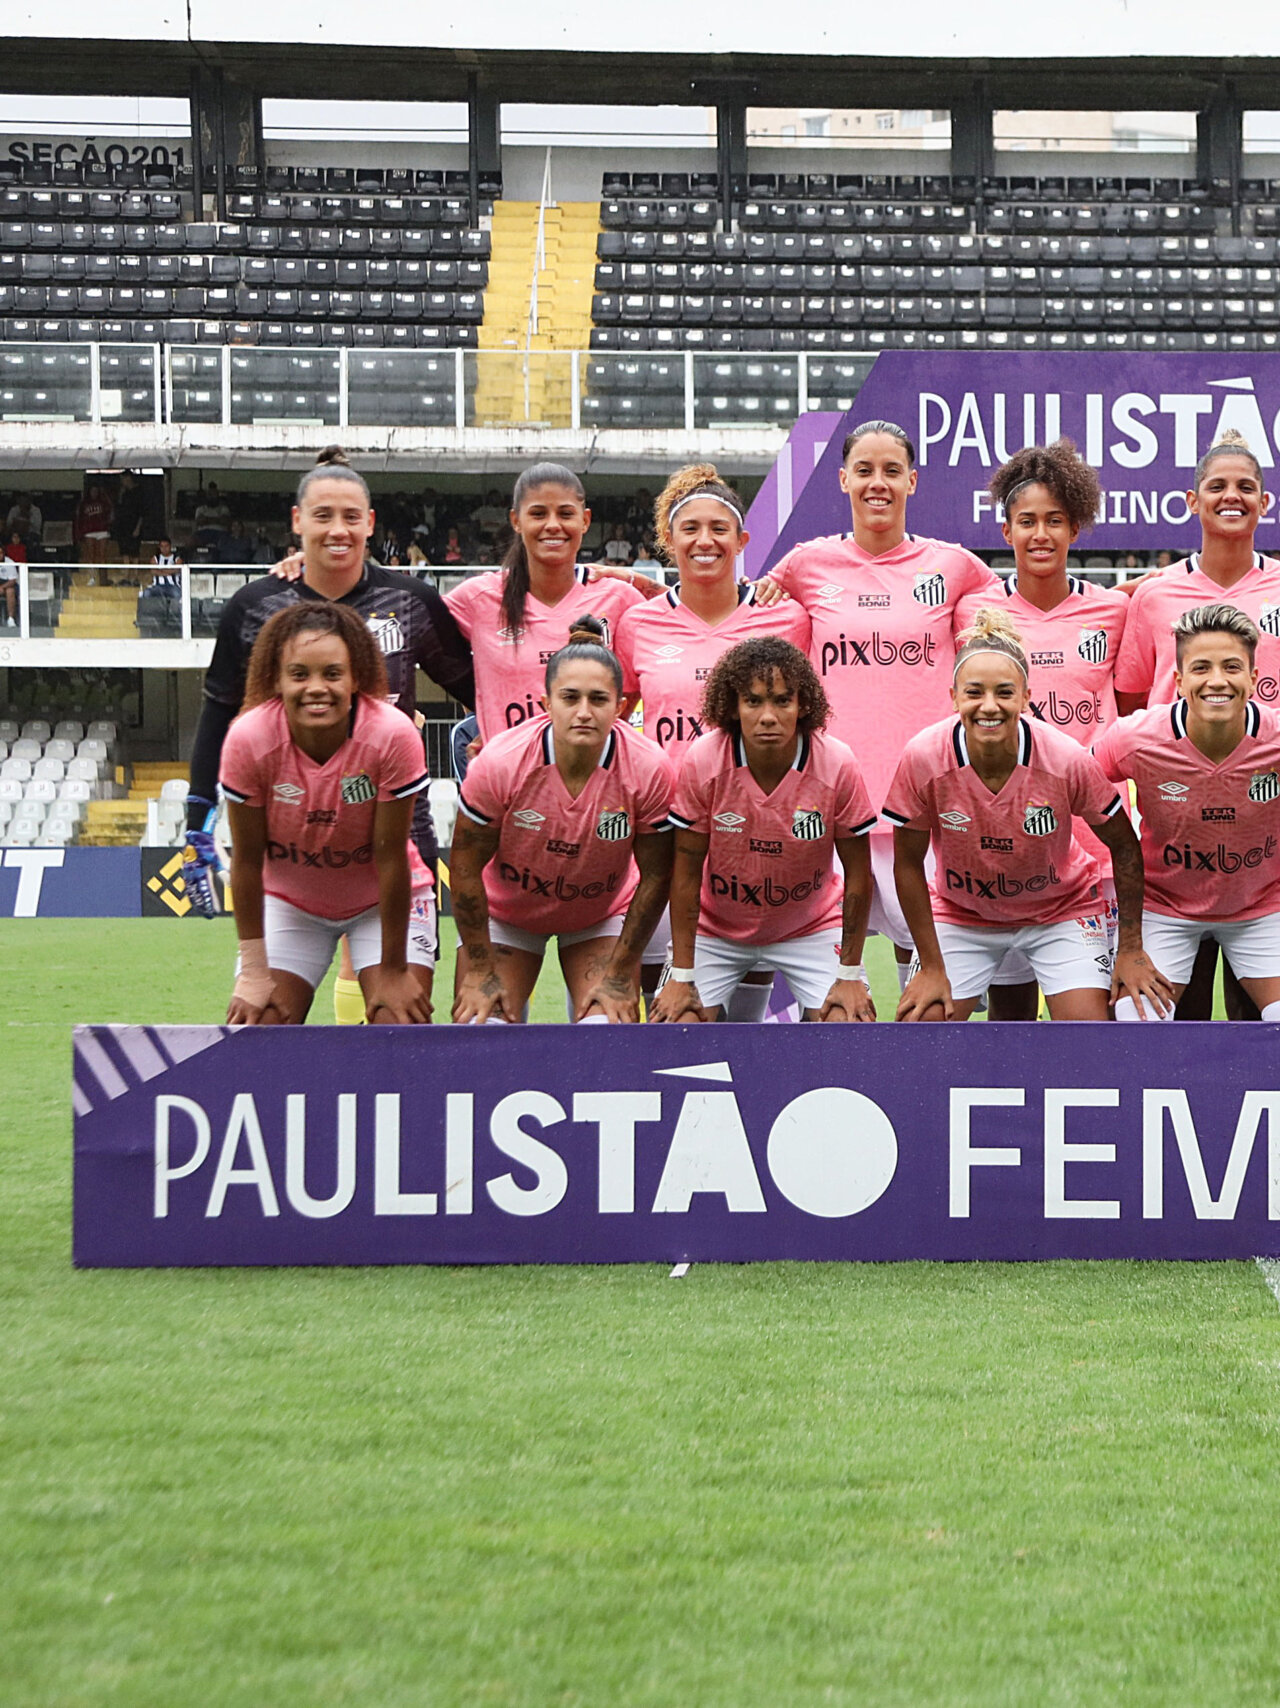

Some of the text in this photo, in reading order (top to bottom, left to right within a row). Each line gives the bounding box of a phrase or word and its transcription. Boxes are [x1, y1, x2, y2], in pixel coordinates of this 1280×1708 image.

[972, 490, 1193, 525] FINO
[822, 631, 936, 676] pixbet
[1029, 691, 1105, 725] xbet
[656, 708, 706, 749] pix
[1161, 794, 1187, 802] umbro
[1202, 807, 1235, 815] TEK
[715, 825, 743, 833] umbro
[941, 823, 967, 832] umbro
[267, 840, 373, 868] pixbe
[750, 846, 782, 854] BOND
[980, 843, 1013, 851] BOND
[1163, 835, 1278, 873] pixbet
[501, 863, 619, 901] pixbet
[710, 868, 823, 906] pixbet
[946, 863, 1061, 899] pixbet
[153, 1061, 899, 1218] PAULISTÃO
